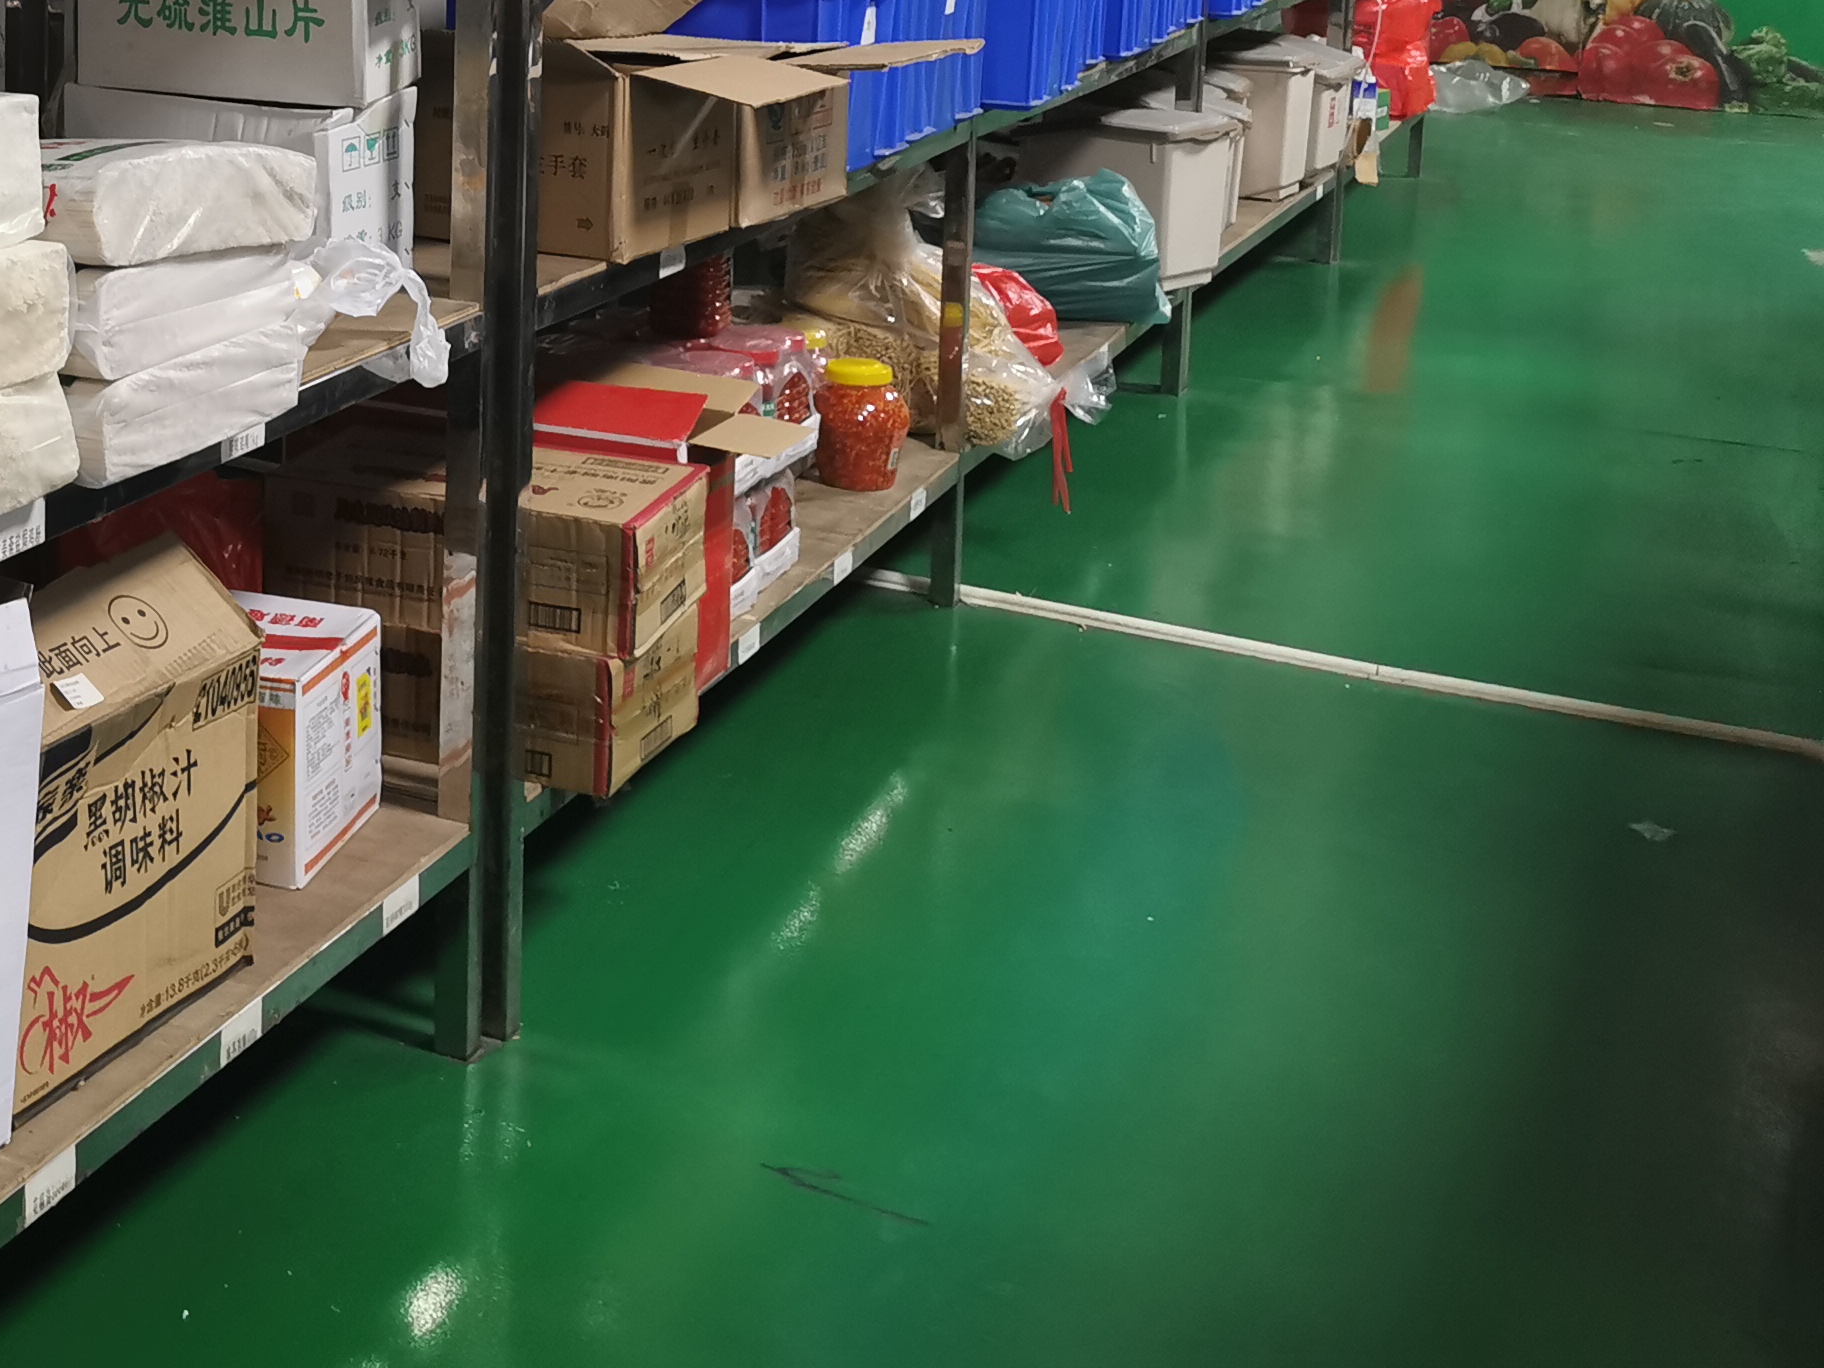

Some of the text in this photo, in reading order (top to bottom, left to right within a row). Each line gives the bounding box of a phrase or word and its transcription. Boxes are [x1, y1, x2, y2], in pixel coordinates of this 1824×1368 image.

[37, 626, 122, 679] 此面向上
[84, 749, 199, 852] 黑胡椒汁
[101, 808, 183, 895] 调味料
